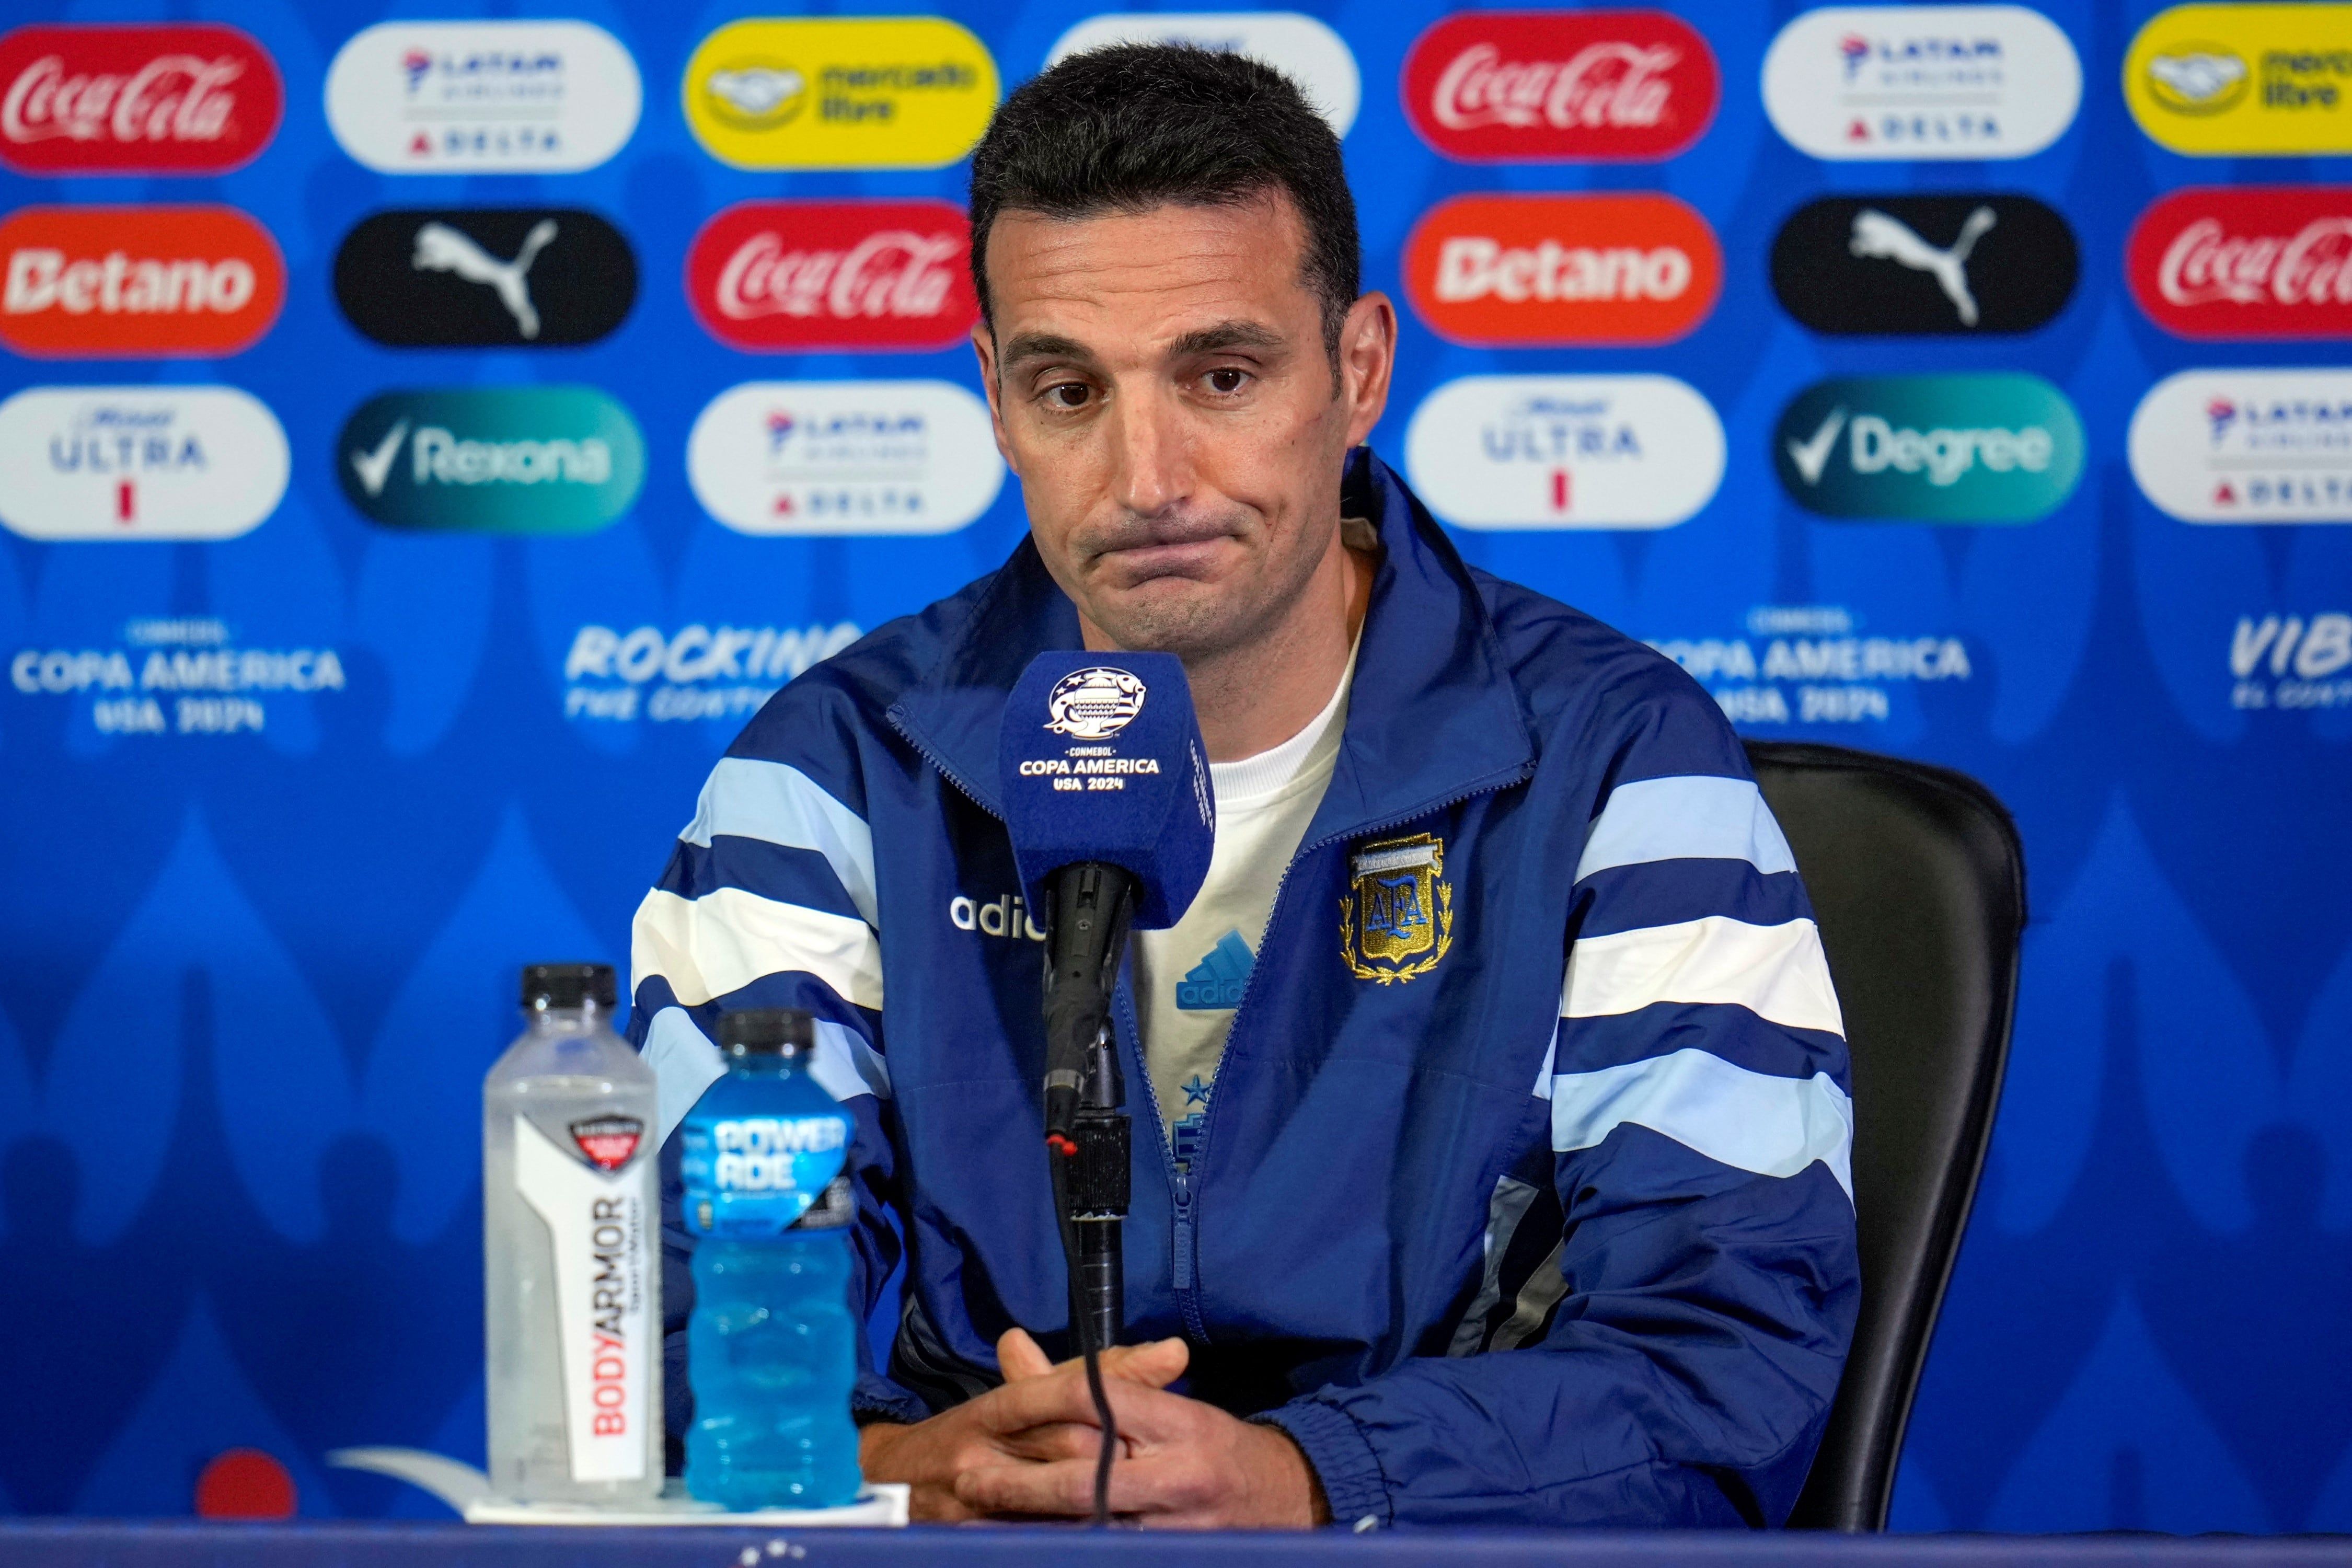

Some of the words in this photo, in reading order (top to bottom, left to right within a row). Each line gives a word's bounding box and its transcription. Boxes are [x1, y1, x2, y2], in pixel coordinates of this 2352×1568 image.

[1880, 39, 2002, 61] LATAM
[444, 130, 559, 154] DELTA
[1882, 115, 2001, 140] DELTA
[4, 249, 255, 314] Betano
[1435, 237, 1691, 302] Betano
[50, 434, 205, 471] ULTRA
[412, 426, 611, 484] Rexona
[1483, 423, 1641, 460] ULTRA
[1851, 417, 2054, 486] Degree
[808, 490, 923, 515] DELTA
[11, 651, 133, 692] COPA
[94, 698, 165, 732] USA
[178, 698, 264, 732] 2024
[1800, 686, 1888, 722] 2024
[1019, 759, 1070, 776] COPA
[1073, 758, 1159, 774] AMERICA
[1053, 778, 1082, 791] USA
[1088, 777, 1124, 790] 2024
[714, 1117, 847, 1153] POWER
[592, 1197, 626, 1436] BODYARMOR
